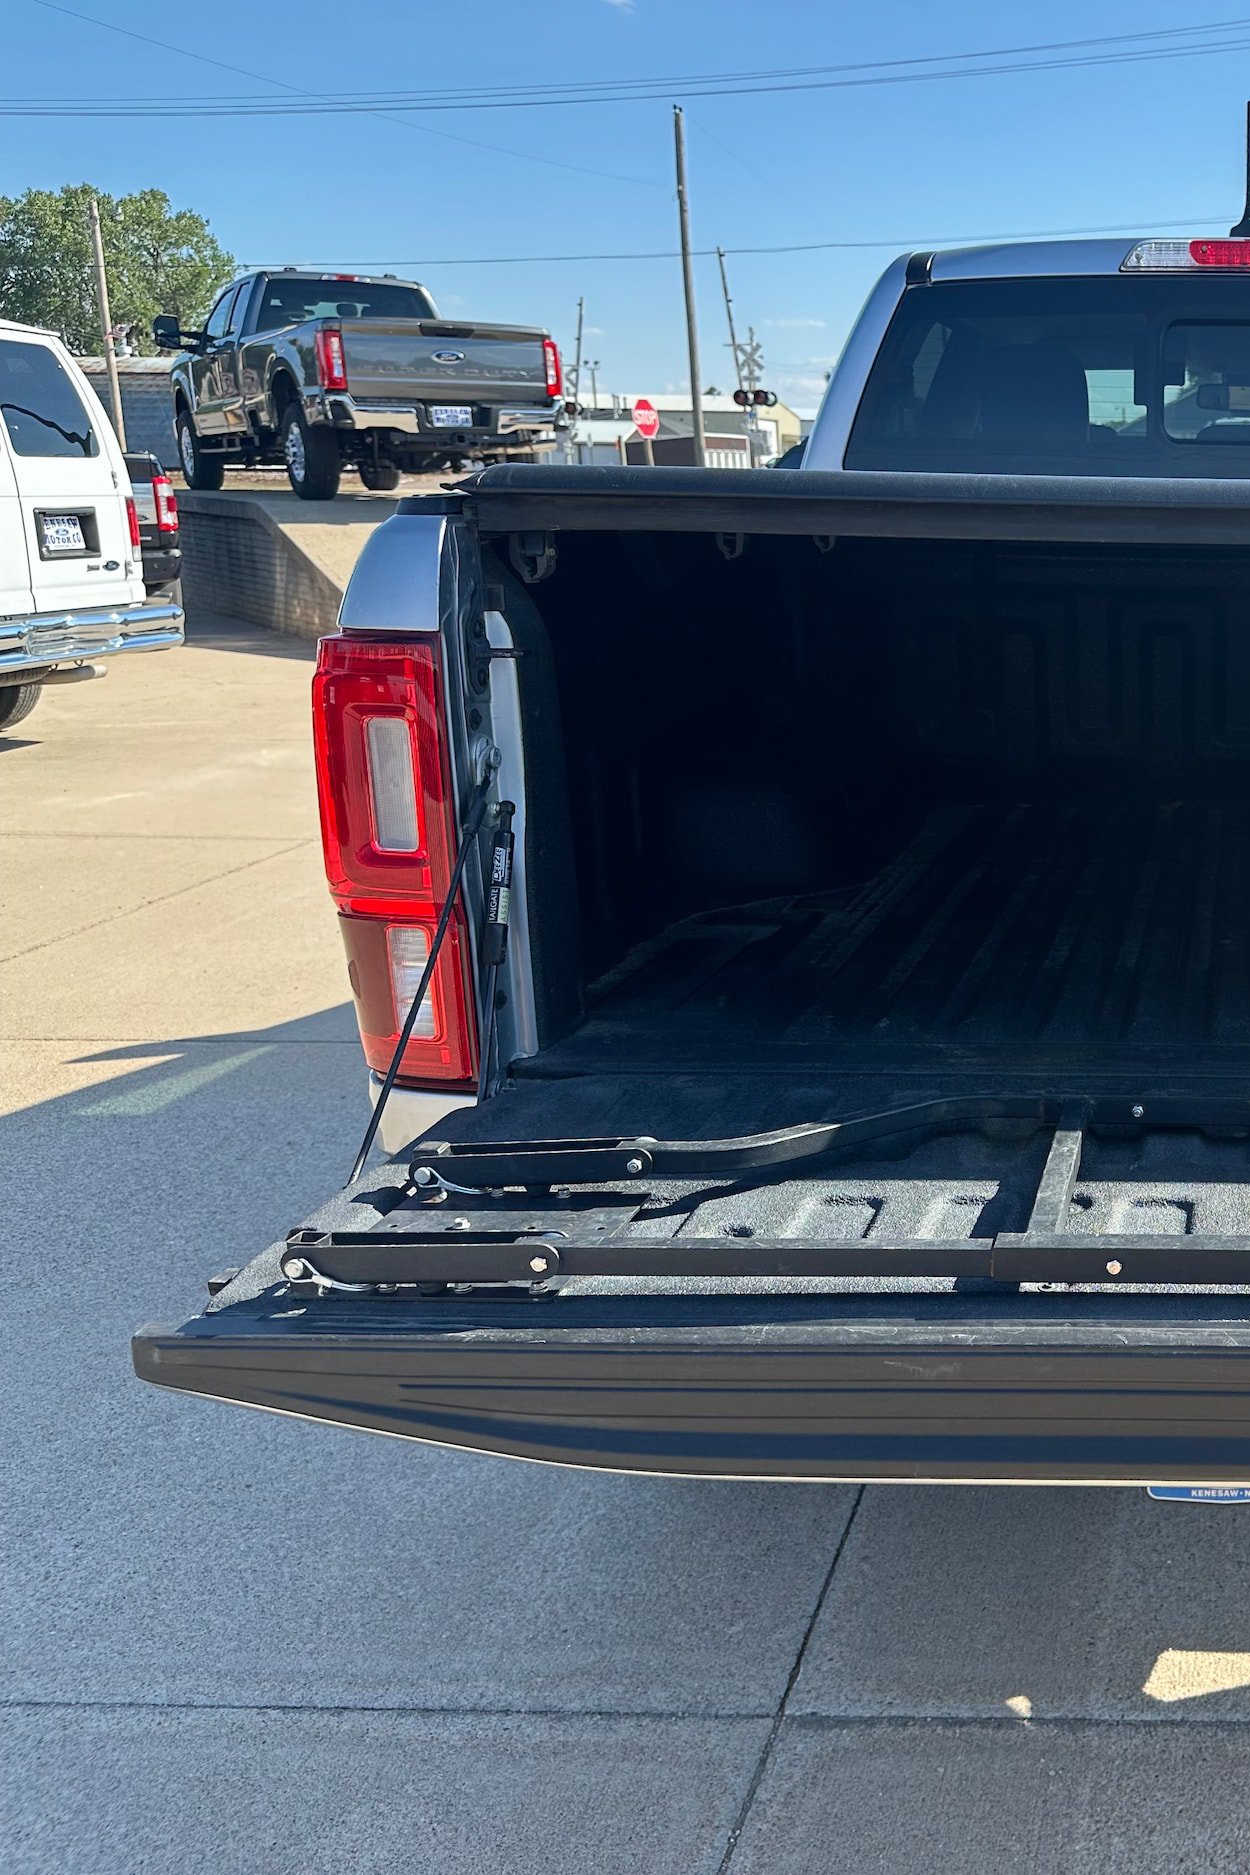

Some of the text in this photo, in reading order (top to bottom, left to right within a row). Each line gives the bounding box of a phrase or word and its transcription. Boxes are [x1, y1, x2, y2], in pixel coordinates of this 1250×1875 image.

[634, 410, 656, 425] STOP
[488, 888, 499, 922] TAILGATE
[501, 889, 510, 922] ASSIST
